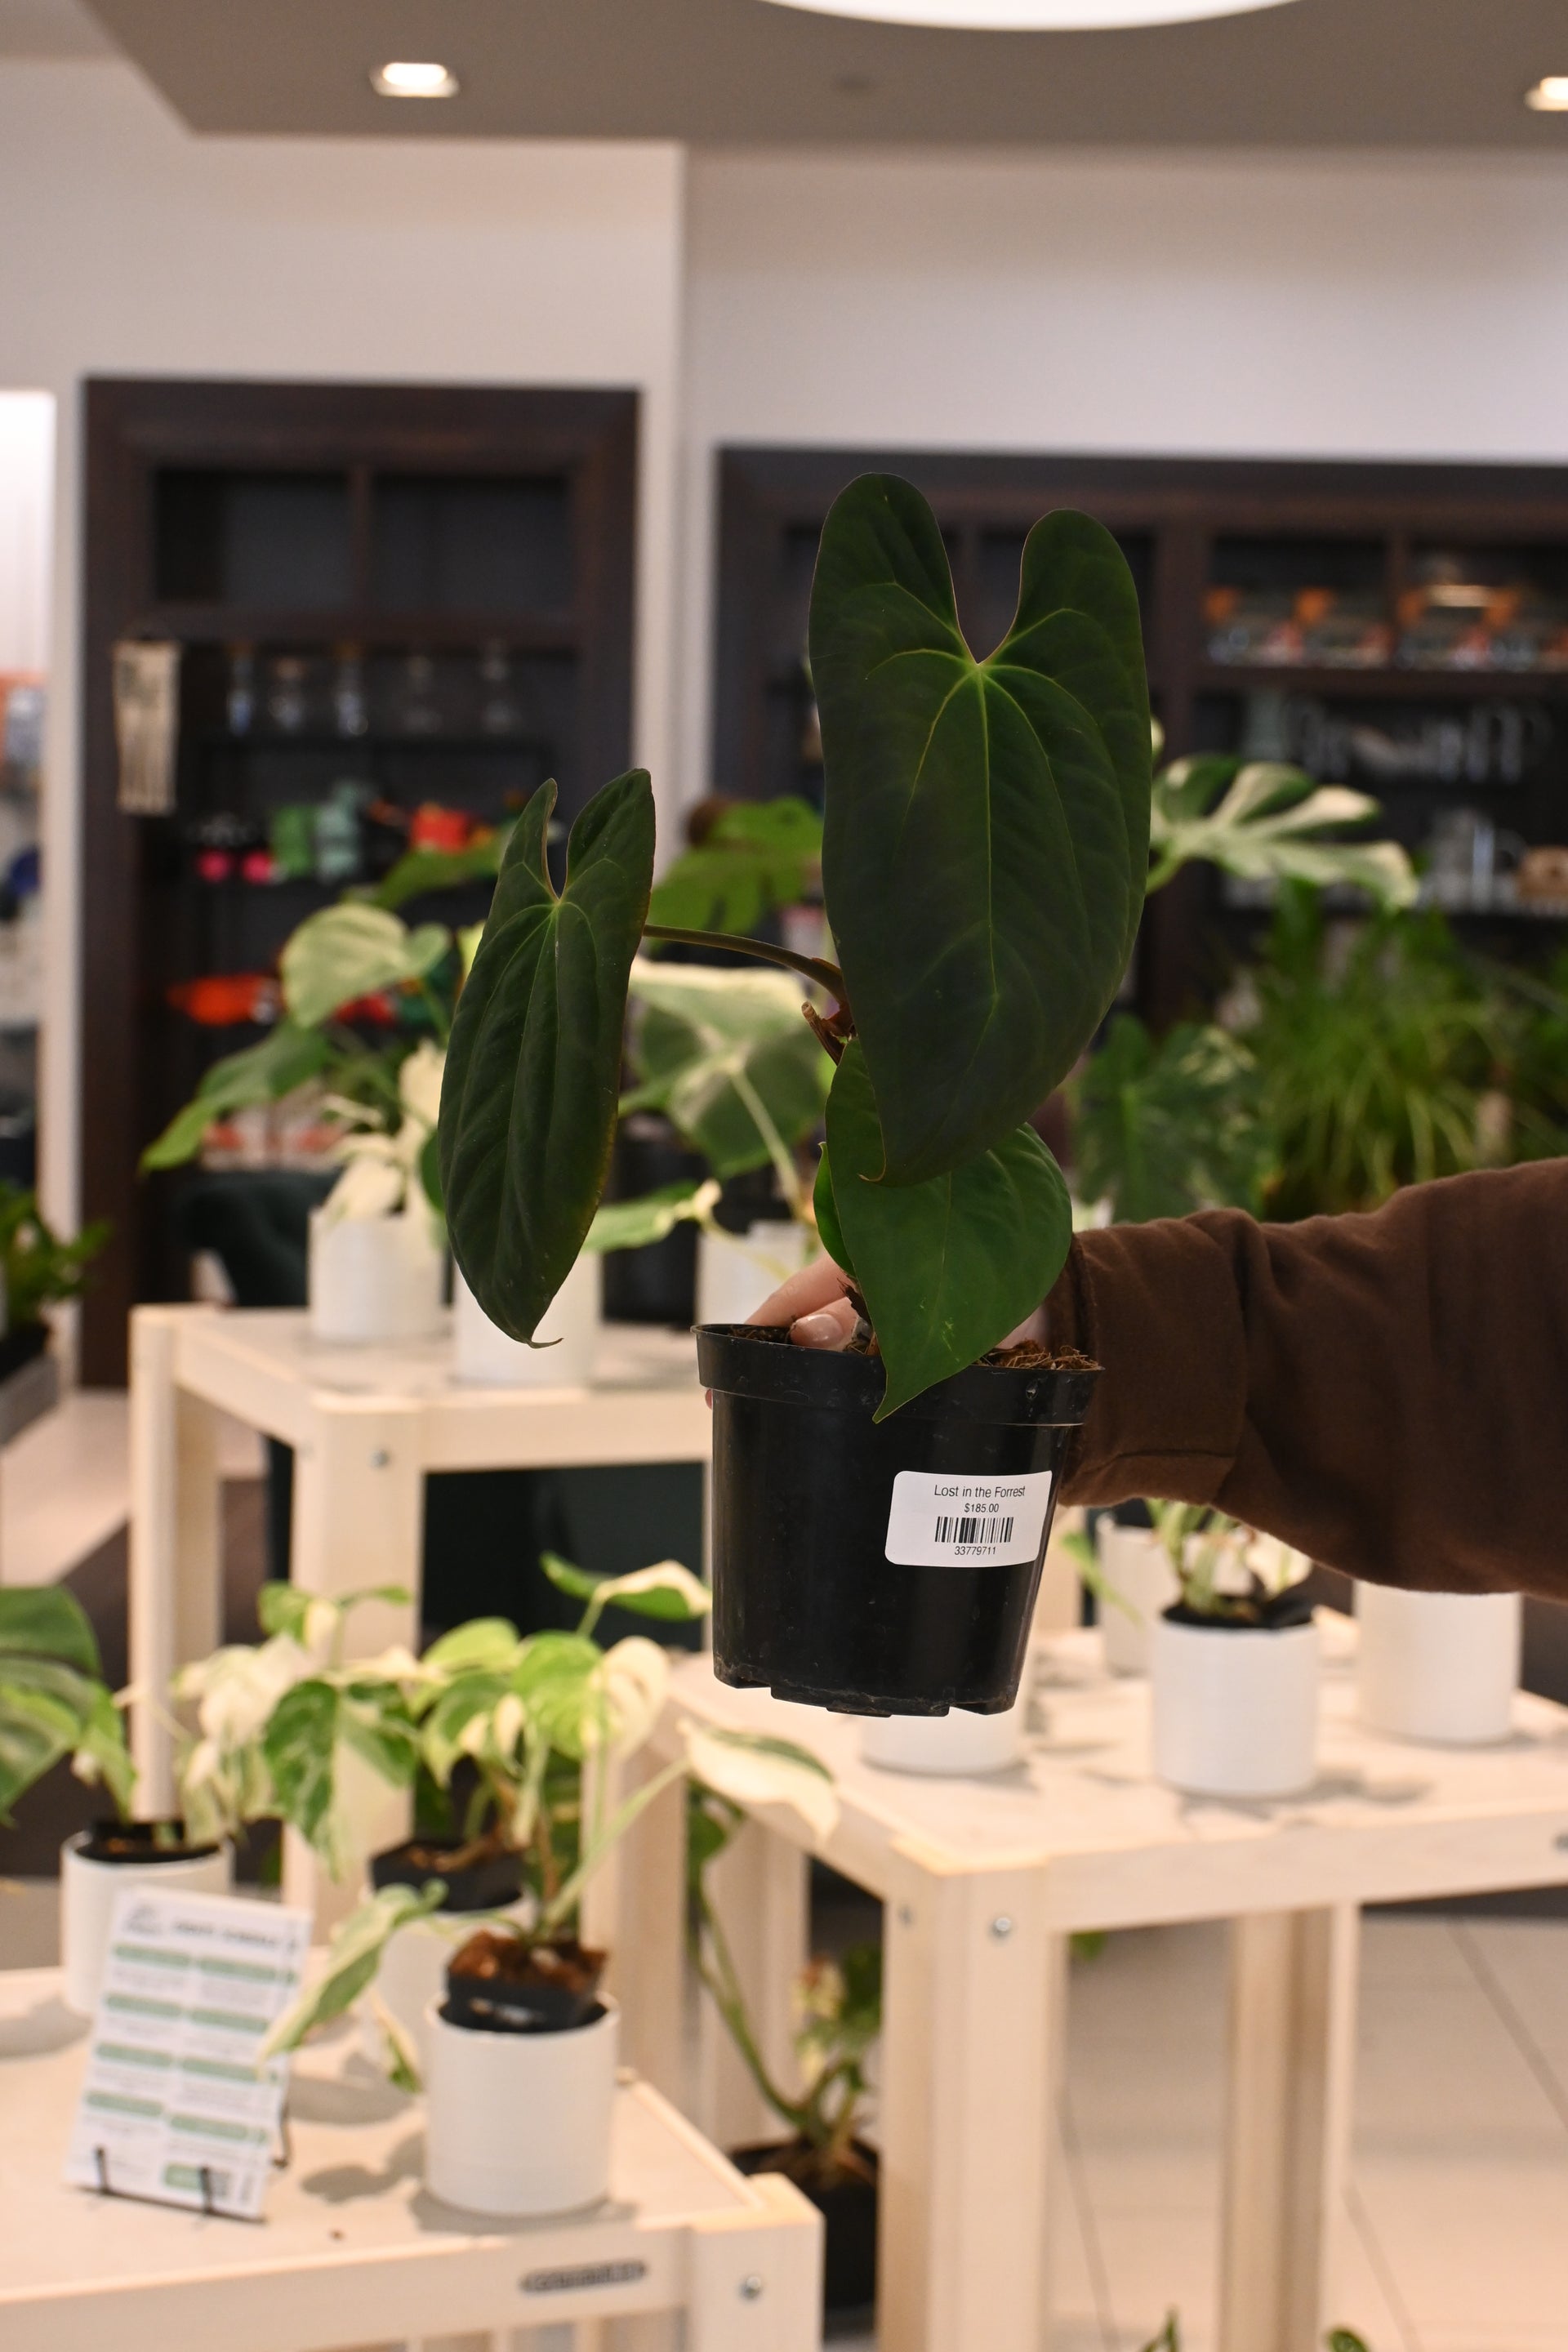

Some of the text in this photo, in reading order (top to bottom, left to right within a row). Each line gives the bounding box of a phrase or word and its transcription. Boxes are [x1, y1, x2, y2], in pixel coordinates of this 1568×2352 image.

[934, 1485, 1026, 1498] Lost in the Forrest
[964, 1503, 1000, 1513] $185.00
[954, 1546, 996, 1556] 33779711
